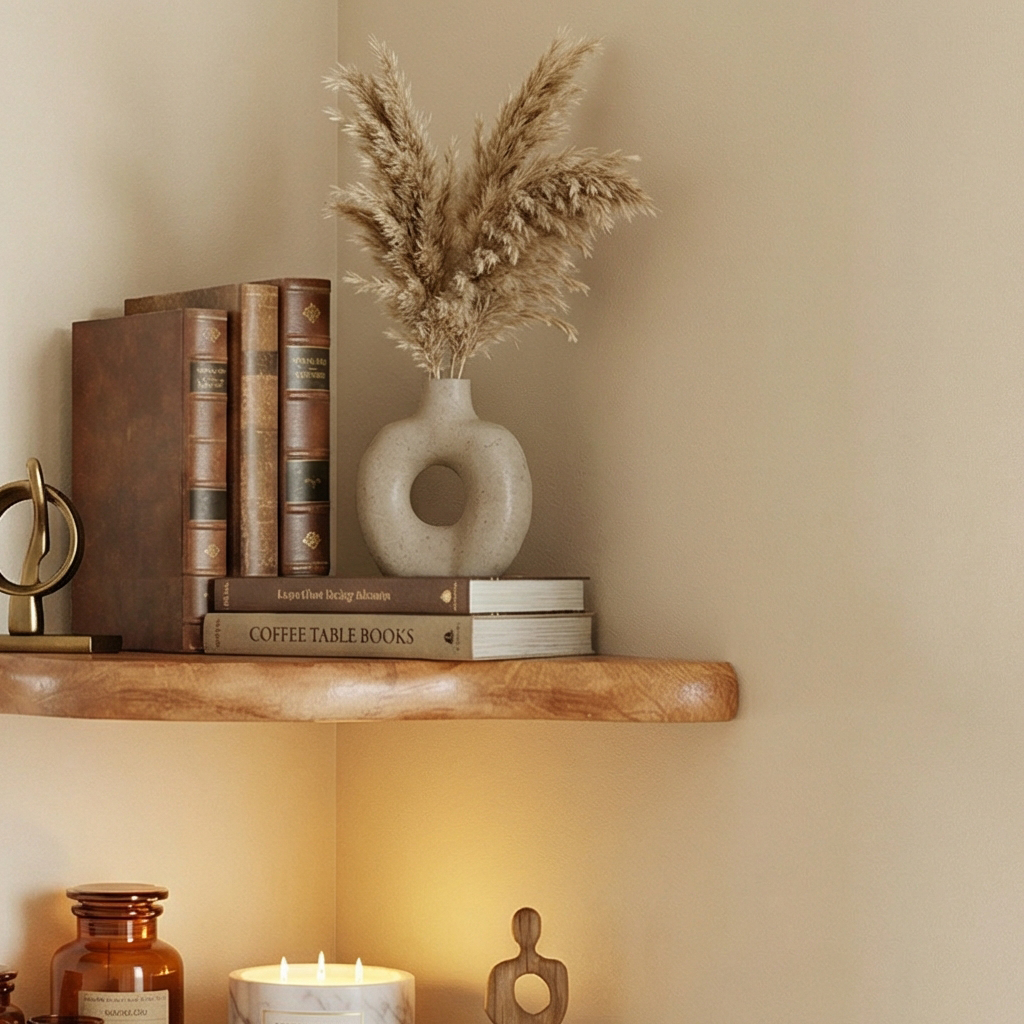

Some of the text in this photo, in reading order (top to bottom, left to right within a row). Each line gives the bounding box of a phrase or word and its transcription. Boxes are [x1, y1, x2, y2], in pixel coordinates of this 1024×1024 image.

[249, 626, 415, 645] COFFEE TABLE BOOKS
